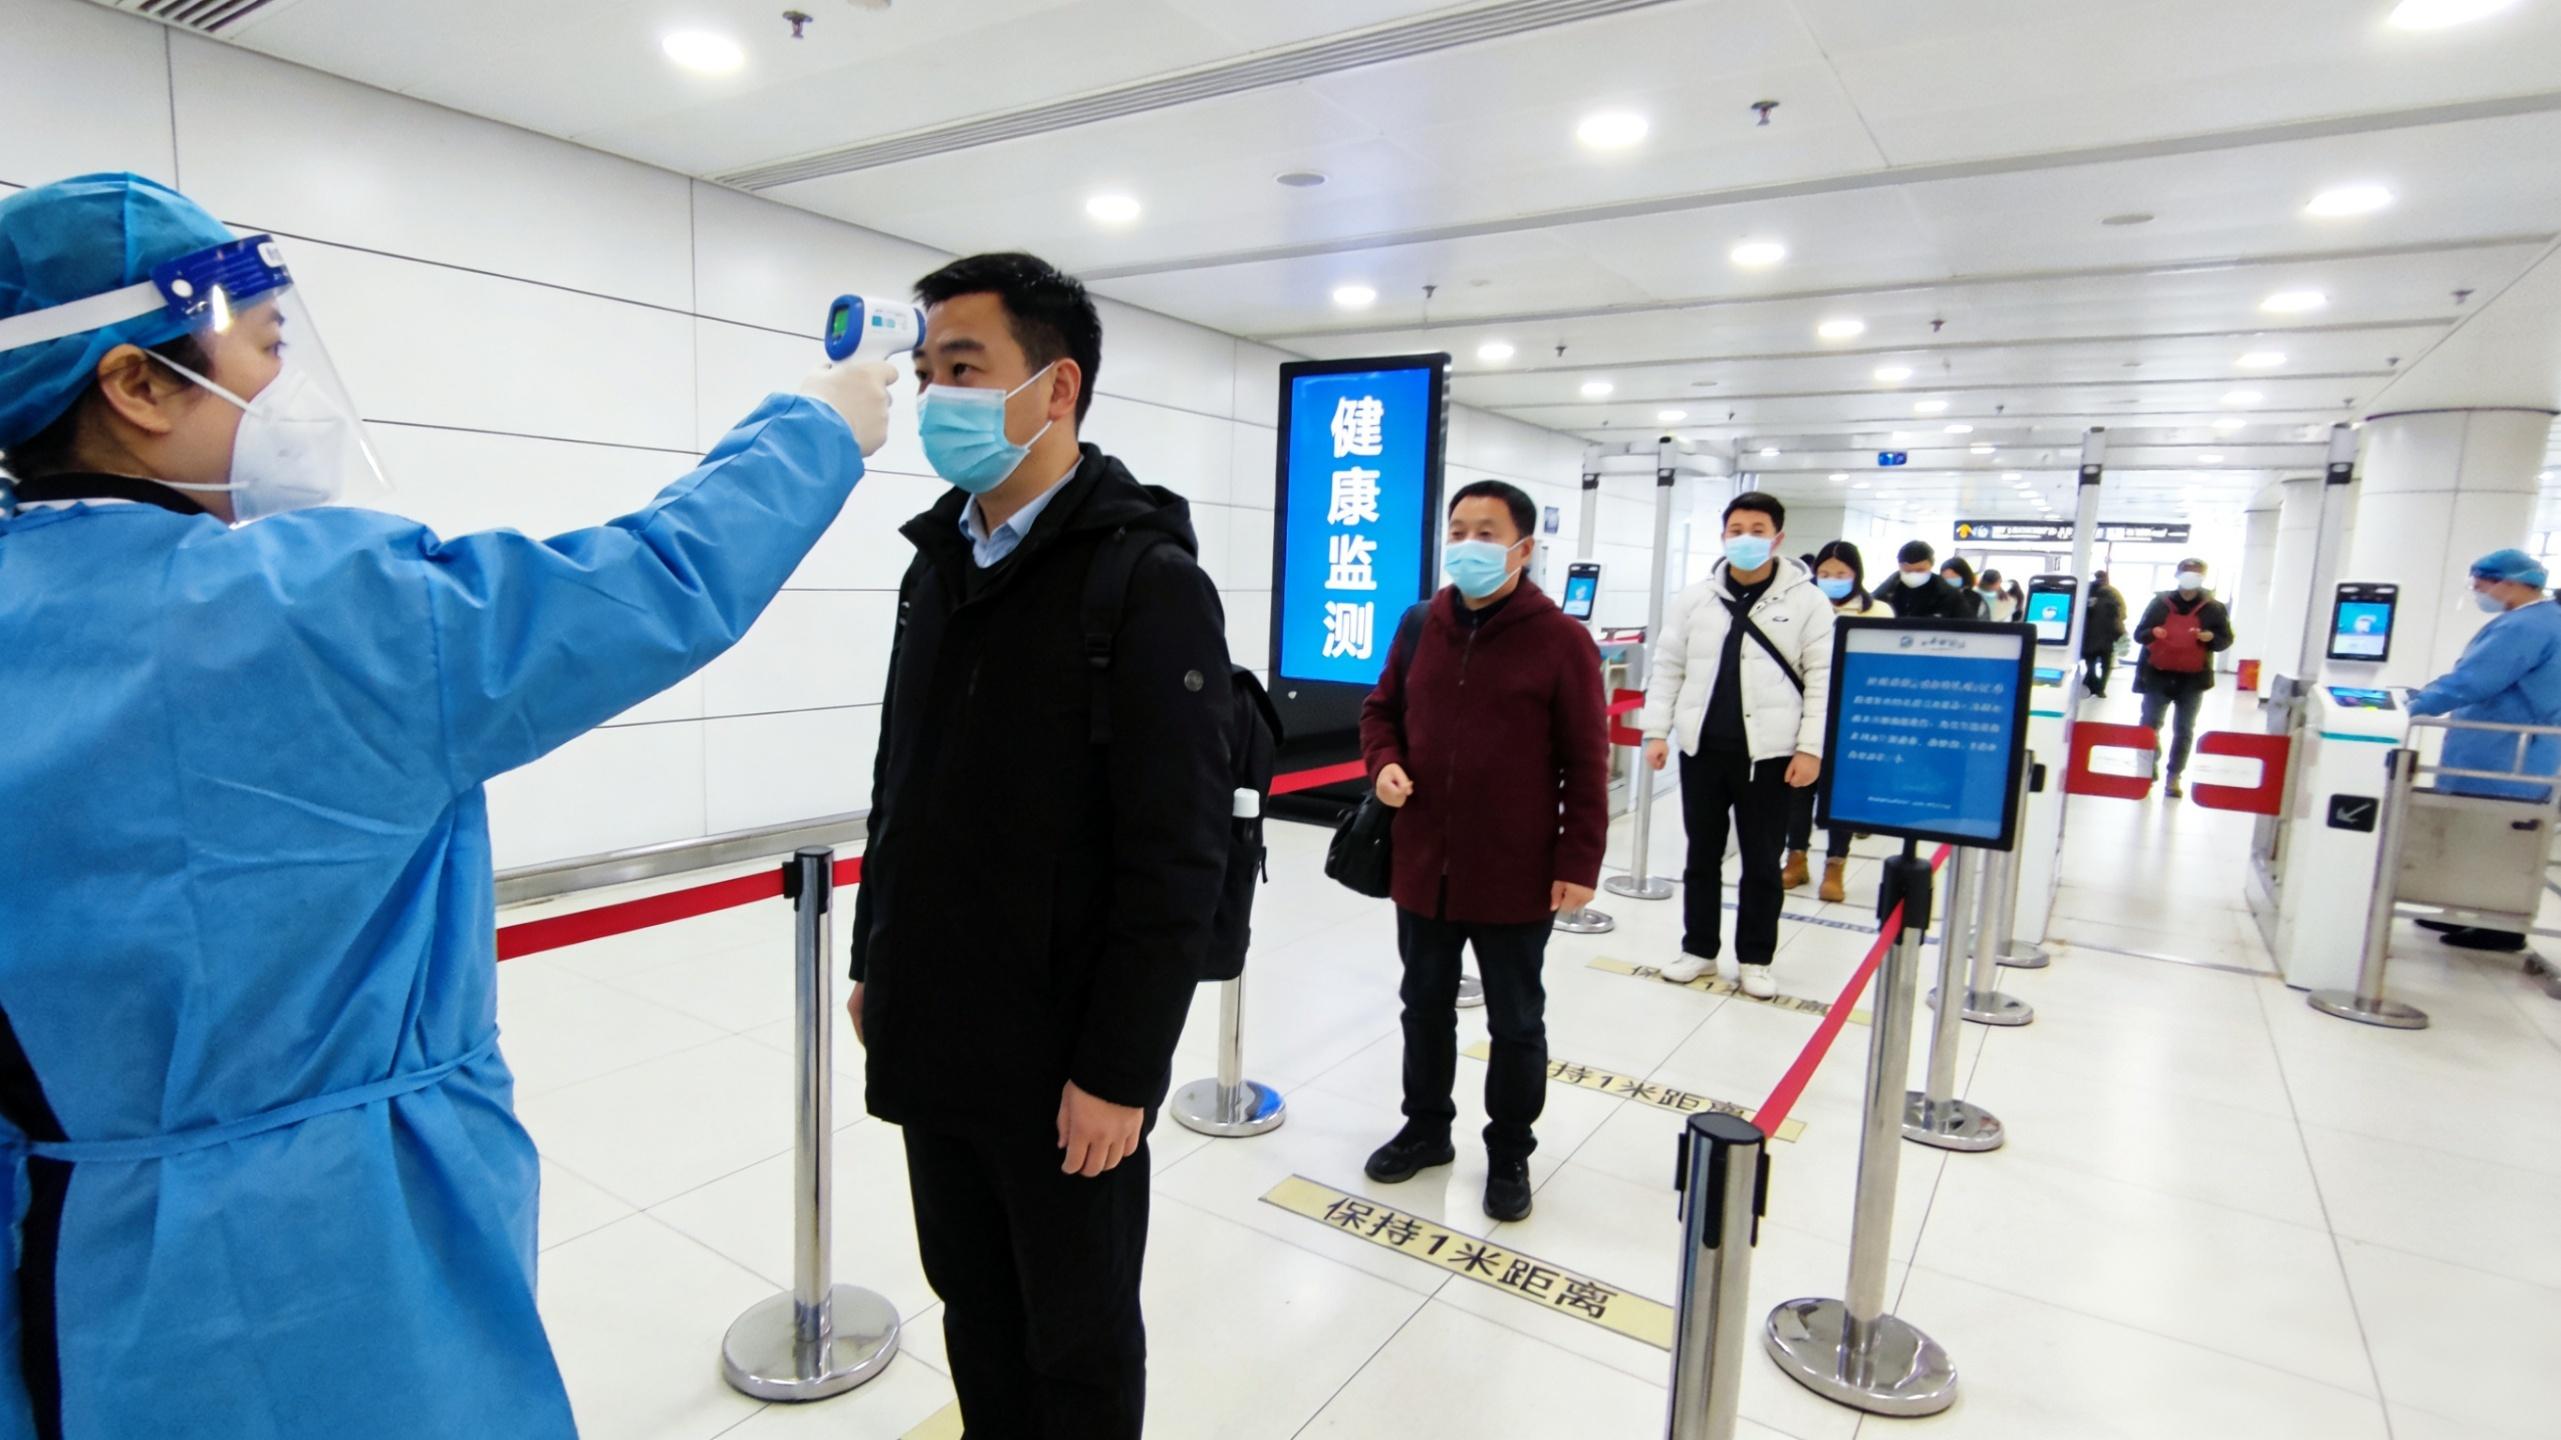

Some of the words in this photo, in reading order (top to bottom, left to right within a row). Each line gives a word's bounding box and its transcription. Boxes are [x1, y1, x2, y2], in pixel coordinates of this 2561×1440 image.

[1322, 396, 1385, 660] 健康监测
[1324, 1197, 1618, 1319] 保持1米距离
